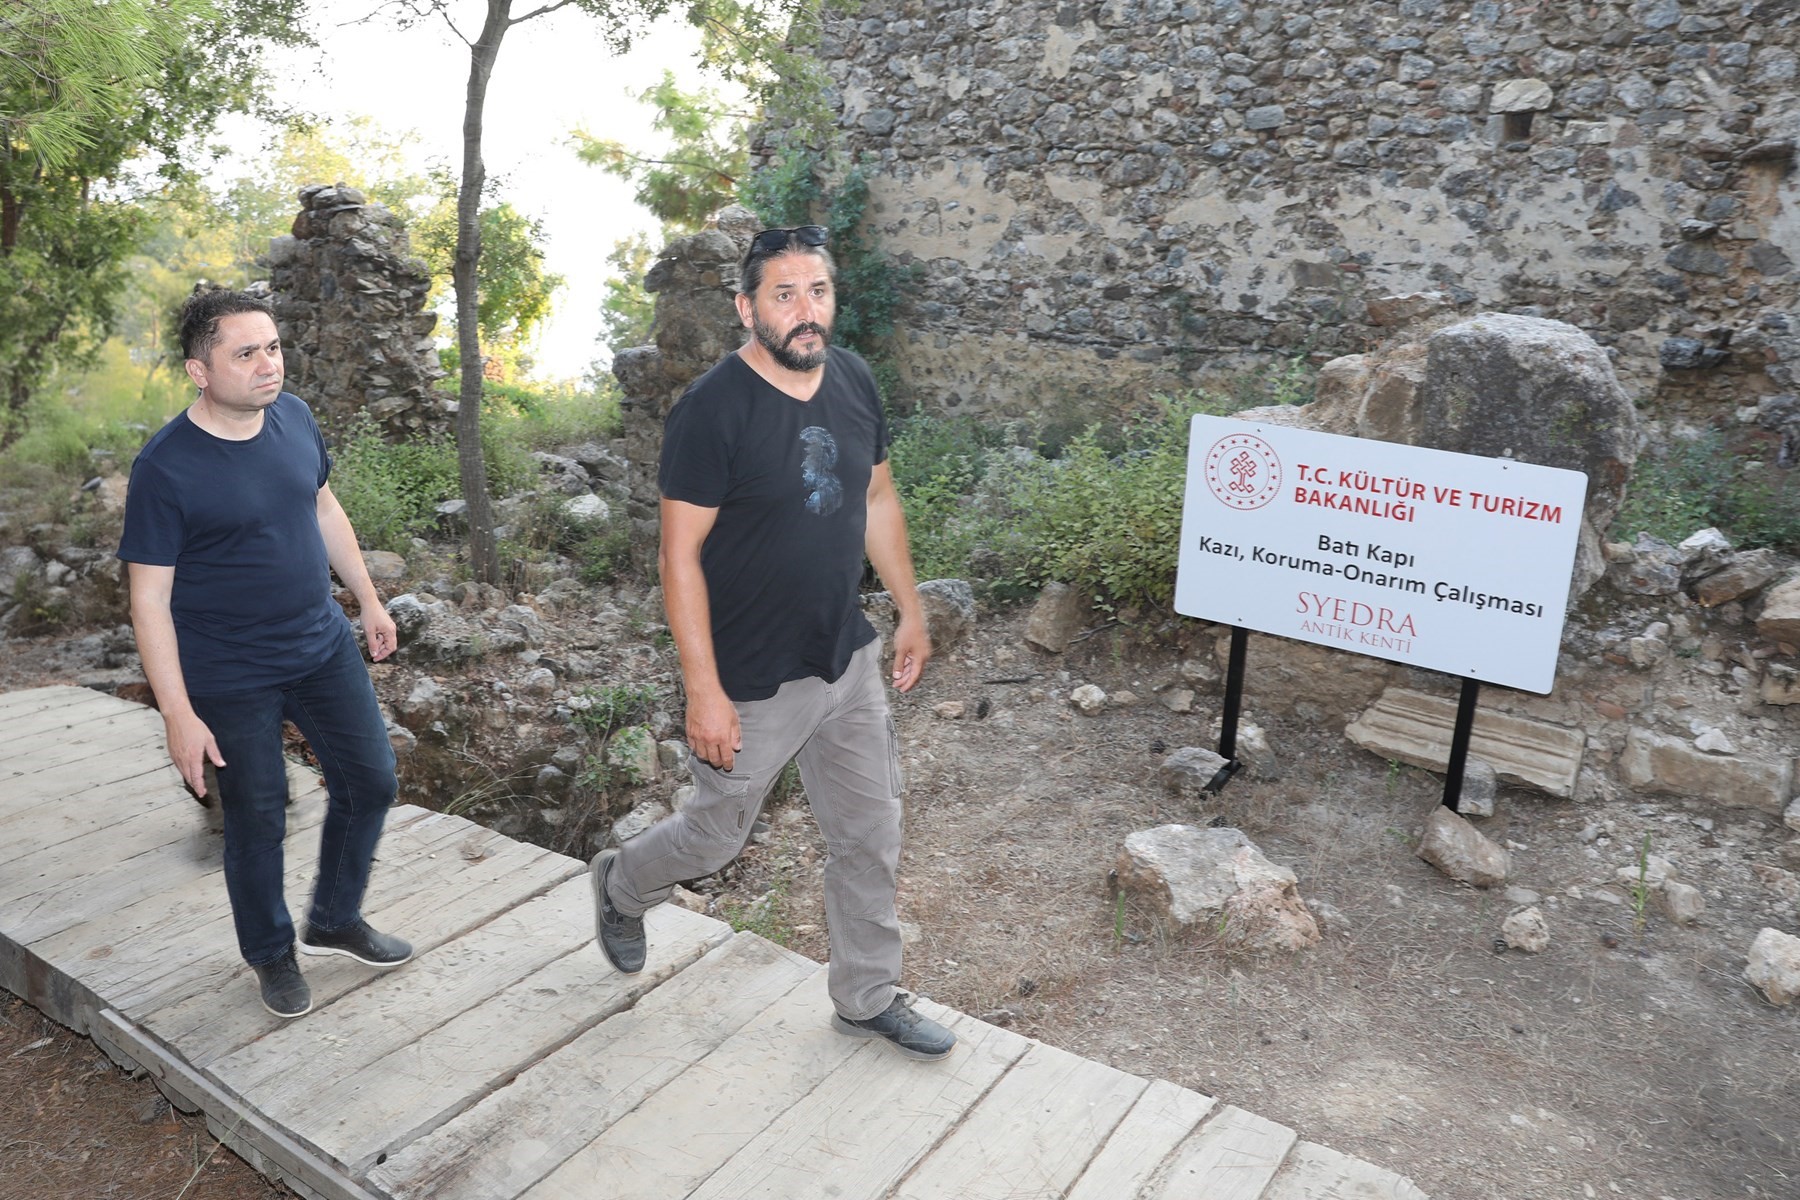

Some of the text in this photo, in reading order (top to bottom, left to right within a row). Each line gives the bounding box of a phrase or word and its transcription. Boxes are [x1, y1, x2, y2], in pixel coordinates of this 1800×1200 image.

[1295, 487, 1415, 522] BAKANLIĞI
[1297, 464, 1562, 523] T.C. KÜLTÜR VE TURİZM
[1318, 534, 1415, 568] Batı Kapı
[1200, 535, 1544, 618] Kazı, Koruma-Onarım Çalışması
[1296, 591, 1417, 637] SYEDRA
[1301, 620, 1412, 654] ANTİK KENTİ
